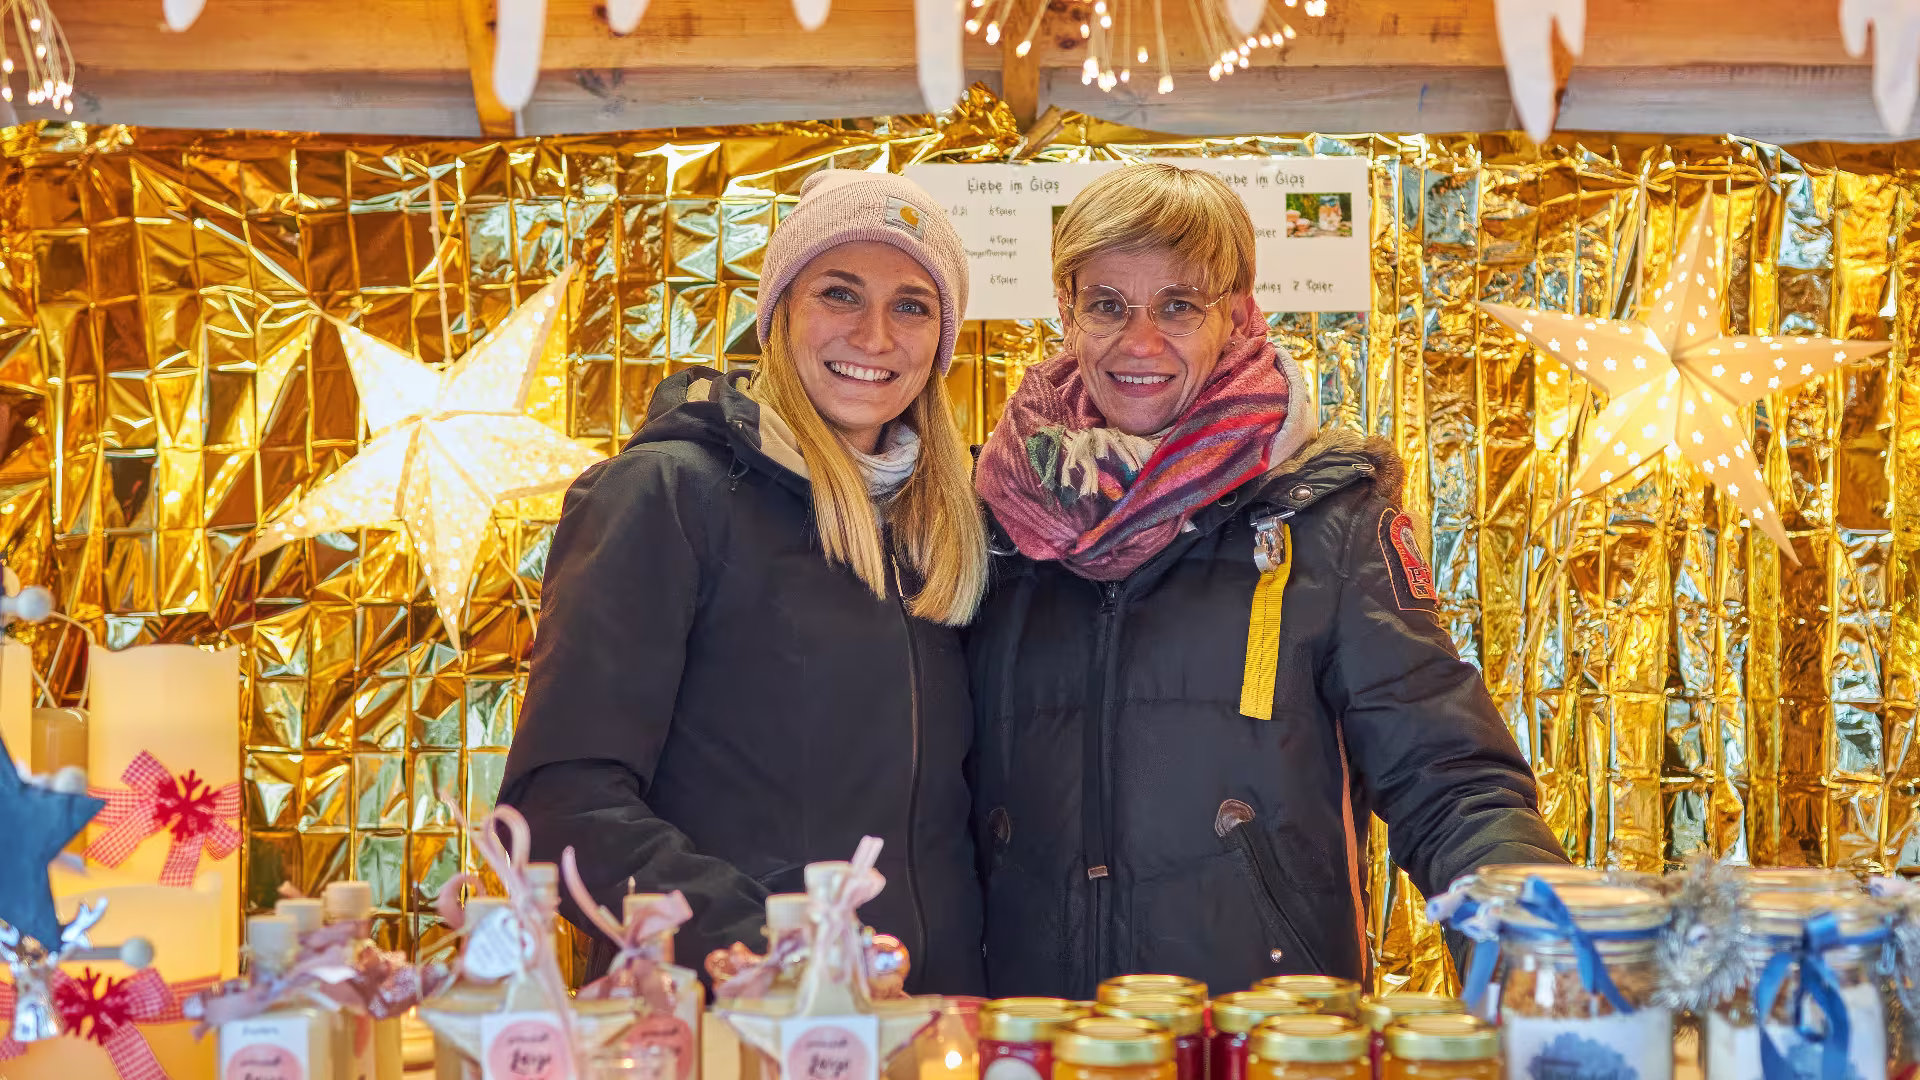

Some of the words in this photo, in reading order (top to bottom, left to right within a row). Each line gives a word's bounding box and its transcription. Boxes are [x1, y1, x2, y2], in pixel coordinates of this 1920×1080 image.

[967, 177, 1003, 194] Liebe
[1010, 179, 1023, 194] im
[1029, 175, 1060, 193] Glas
[1255, 172, 1269, 188] im
[1275, 170, 1305, 188] Glas
